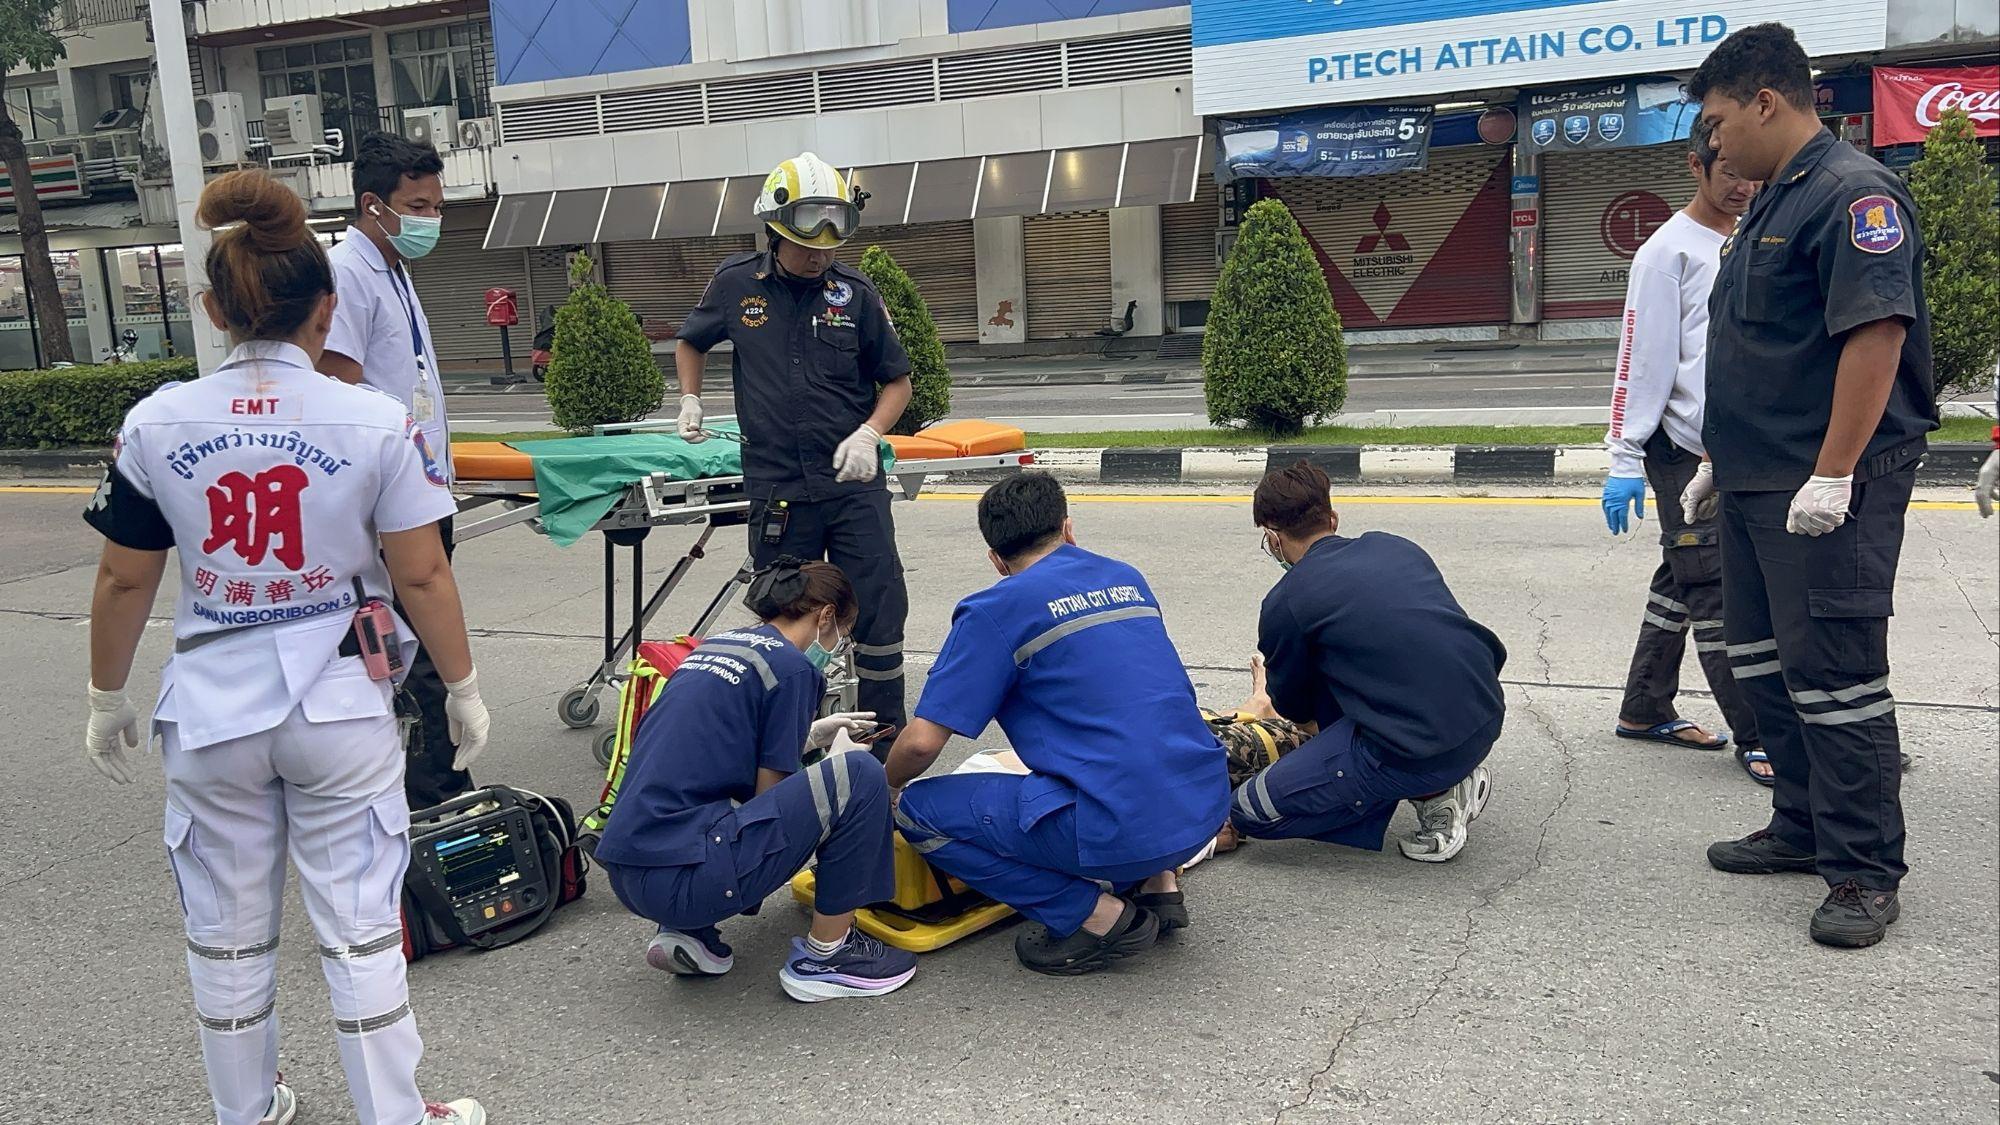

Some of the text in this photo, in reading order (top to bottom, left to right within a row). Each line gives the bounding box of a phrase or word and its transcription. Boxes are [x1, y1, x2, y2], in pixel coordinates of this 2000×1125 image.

[1309, 14, 1728, 83] P.TECH ATTAIN CO. LTD
[1572, 119, 1581, 128] 5
[1604, 117, 1618, 126] 10
[1398, 118, 1416, 140] 5
[1320, 151, 1328, 160] 5
[1351, 151, 1358, 160] 5
[1385, 148, 1396, 158] 10
[1515, 214, 1534, 223] TCL
[1353, 256, 1413, 267] MITSUBISHI
[1353, 266, 1406, 278] ELECTRIC
[745, 307, 764, 315] 4224
[741, 314, 769, 328] RESCUE
[231, 398, 280, 415] EMT
[166, 428, 352, 480] กู้ชีพสว่างบริบูรณ์
[195, 565, 335, 607] 明满善坛
[342, 592, 352, 606] 9
[1047, 585, 1146, 619] PATTAYA CITY HOSPITAL
[713, 655, 747, 674] MEDICINE
[709, 664, 741, 685] PHAYAO
